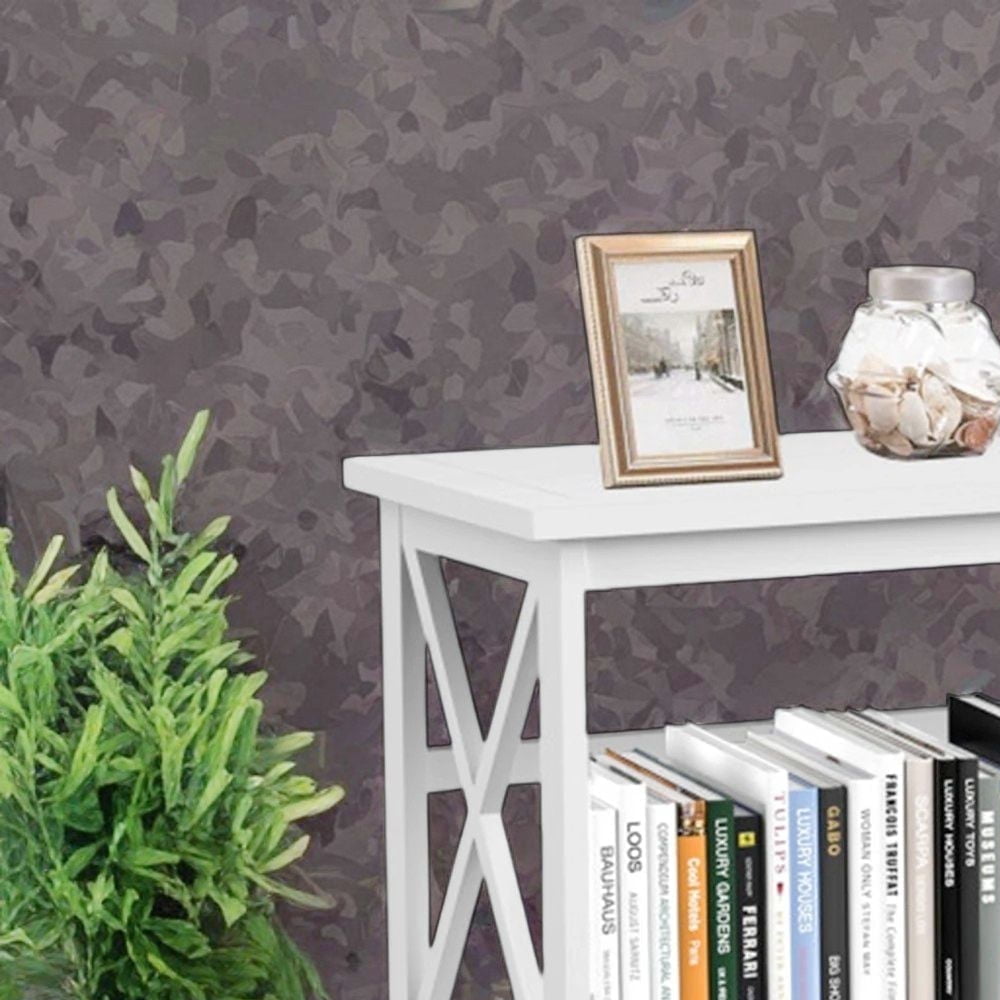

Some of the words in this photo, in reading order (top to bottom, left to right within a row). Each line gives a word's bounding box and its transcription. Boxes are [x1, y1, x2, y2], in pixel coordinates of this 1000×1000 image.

[826, 805, 841, 856] GABO
[943, 779, 954, 830] LUXURY
[964, 779, 976, 829] LUXURY
[627, 821, 642, 874] LOOS
[715, 817, 730, 878] LUXURY
[774, 792, 786, 875] TULIPS
[796, 808, 811, 868] LUXURY
[860, 808, 871, 860] WOMAN
[914, 794, 929, 869] SCARPA
[964, 832, 976, 868] TOYS
[981, 810, 996, 905] MUSEUMS
[657, 822, 670, 896] COMPENDIUM
[687, 857, 701, 887] Cool
[861, 863, 872, 898] ONLY
[886, 843, 898, 897] TRUFFAT
[943, 833, 955, 888] HOUSES
[600, 845, 616, 936] BAUHAUS
[629, 891, 640, 933] AUGUST
[687, 889, 702, 932] Hotels
[798, 871, 813, 933] HOUSES
[659, 898, 672, 983] ARCHITECTURAL
[716, 881, 731, 955] GARDENS
[742, 905, 758, 979] FERRARI
[688, 939, 702, 966] Paris
[828, 955, 841, 976] BIG
